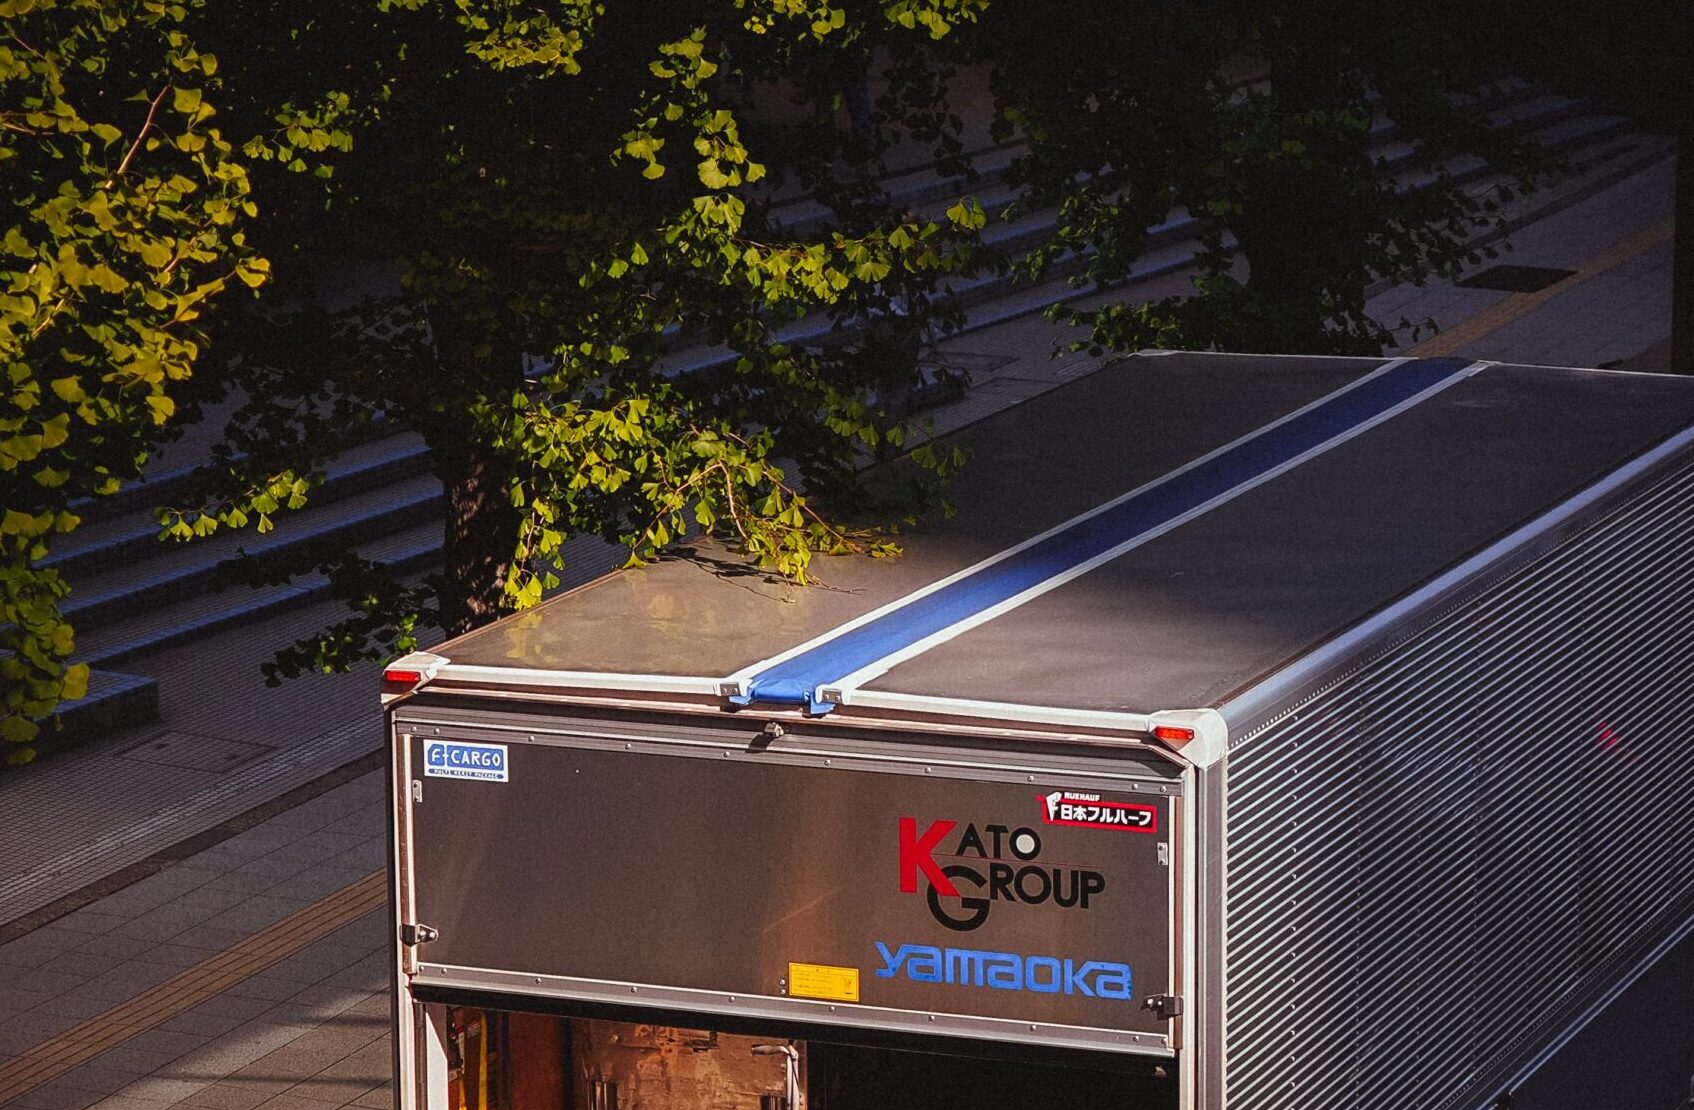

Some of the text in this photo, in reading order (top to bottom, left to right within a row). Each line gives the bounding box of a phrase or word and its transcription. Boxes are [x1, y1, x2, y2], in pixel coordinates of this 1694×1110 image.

[1060, 803, 1152, 826] 日本フルハーフ
[899, 817, 1042, 898] KATO
[926, 862, 1106, 932] GROUP
[874, 941, 1132, 1000] yamaoka
